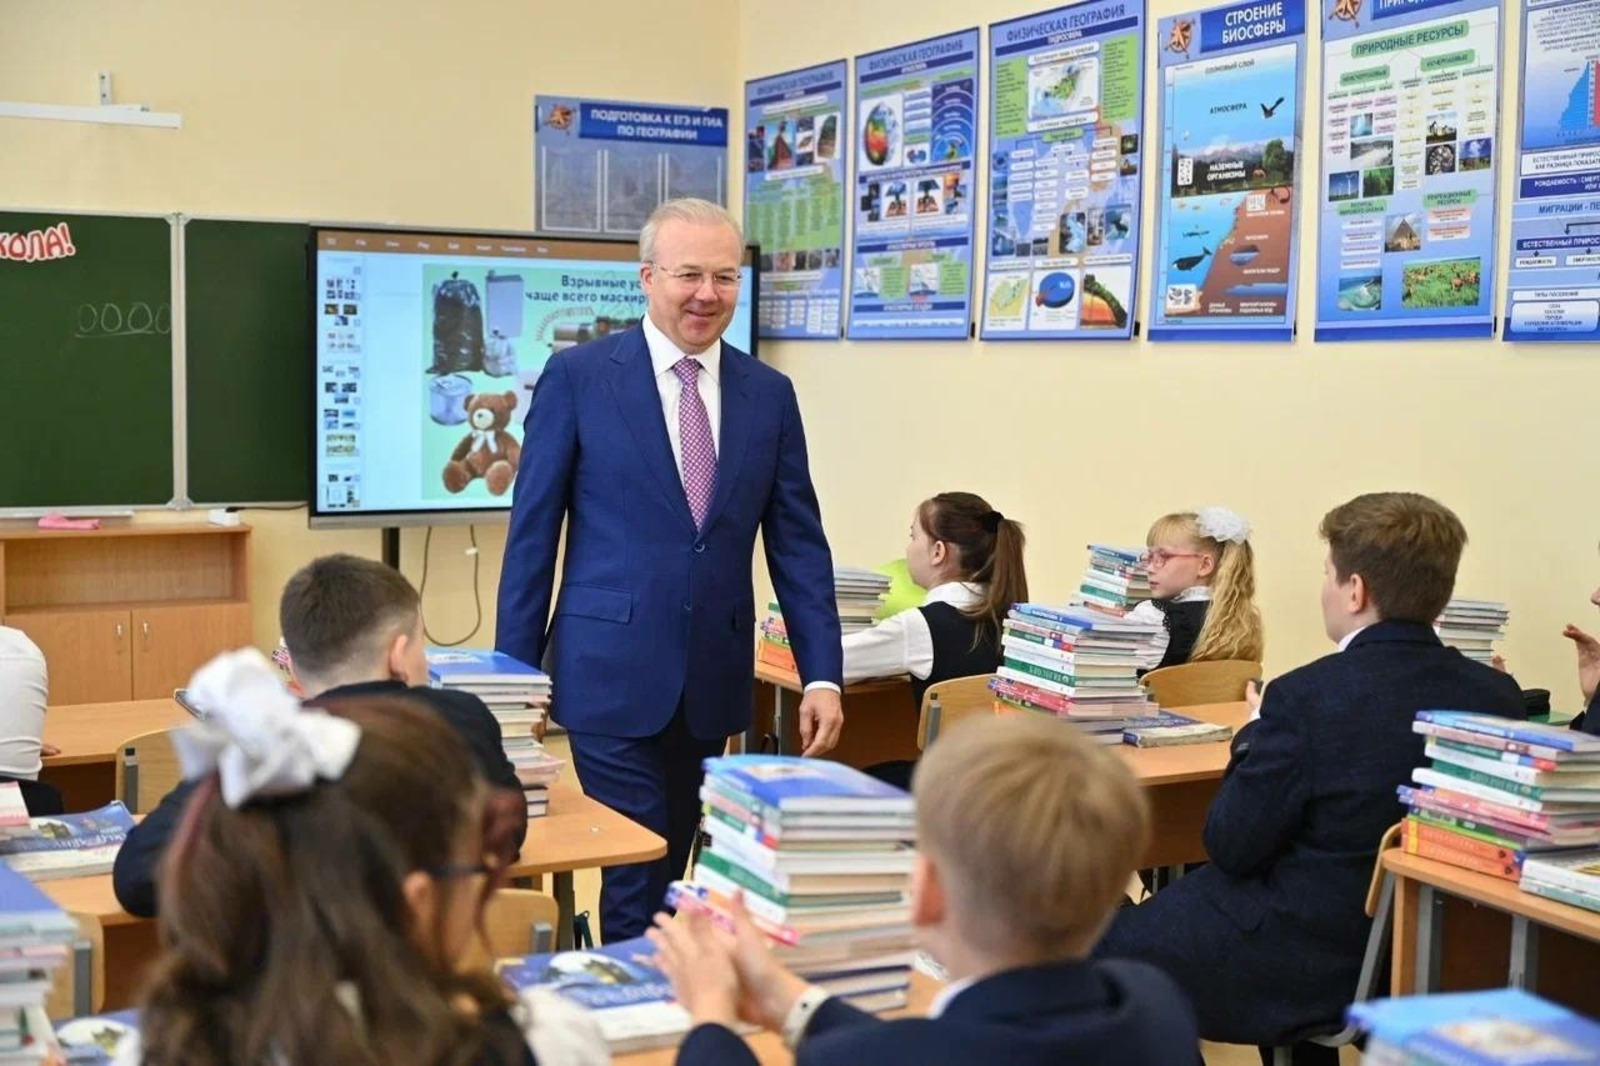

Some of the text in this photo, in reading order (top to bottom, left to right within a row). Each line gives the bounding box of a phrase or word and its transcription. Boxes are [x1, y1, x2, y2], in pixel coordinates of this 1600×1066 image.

[1225, 2, 1283, 26] СТРОЕНИЕ
[1007, 4, 1126, 42] ФИЗИЧЕСКАЯ ГЕОГРАФИЯ
[1222, 19, 1286, 44] БИОСФЕРЫ
[1355, 24, 1464, 55] ПРИРОДНЫЕ РЕСУРСЫ
[1209, 103, 1247, 114] АТМОСФЕРА
[590, 109, 723, 128] ПОДГОТОВКА К ЕГЭ И ГИА
[617, 125, 698, 140] ПО ГЕОГРАФИИ
[1209, 161, 1244, 172] НАЗЕМНЫЕ
[1207, 169, 1246, 181] ОРГАНИЗМЫ
[1538, 203, 1583, 214] МИГРАЦИИ
[1523, 238, 1572, 248] ЕСТЕСТВЕННЫЙ
[561, 275, 641, 290] Взрывные ус
[525, 291, 646, 304] чаще всего маскир
